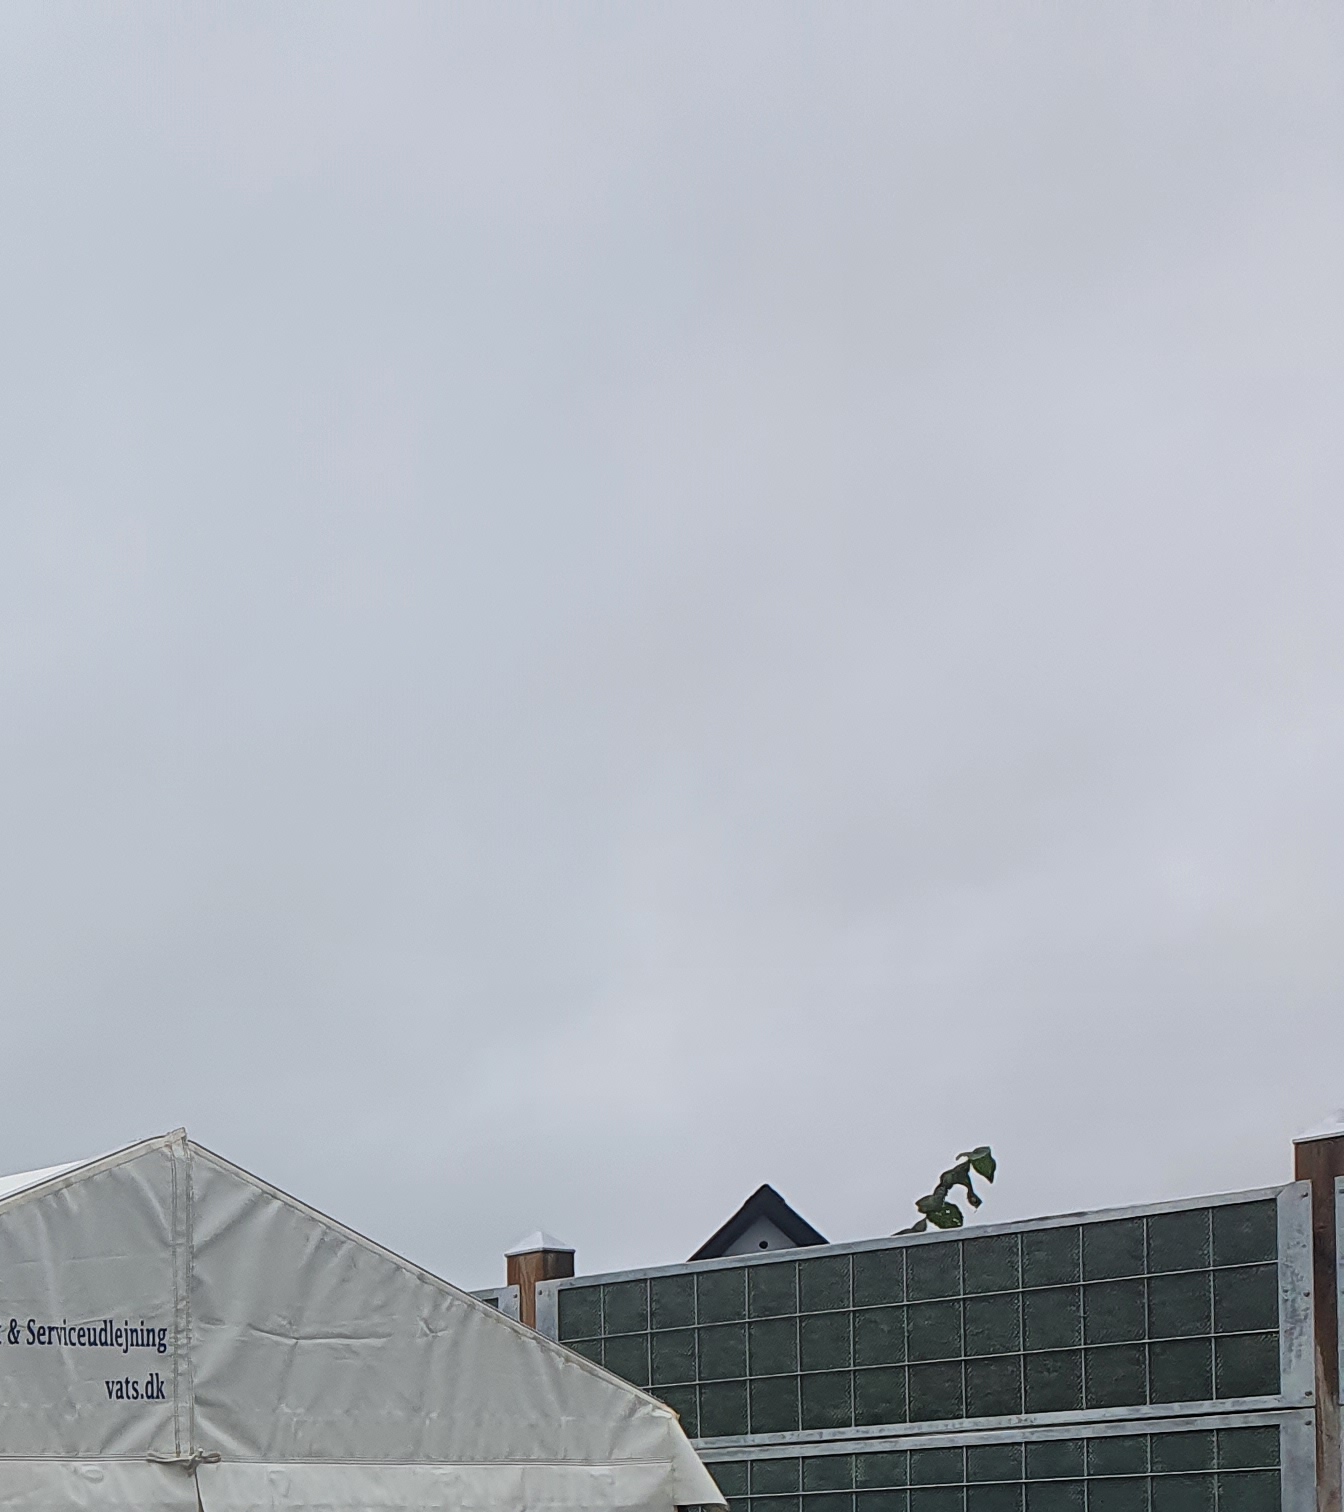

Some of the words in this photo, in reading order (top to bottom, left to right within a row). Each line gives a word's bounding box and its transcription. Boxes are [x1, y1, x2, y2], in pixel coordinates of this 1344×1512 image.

[7, 1318, 21, 1345] &
[26, 1319, 168, 1353] Serviceudlejning
[105, 1373, 165, 1400] vats.dk
